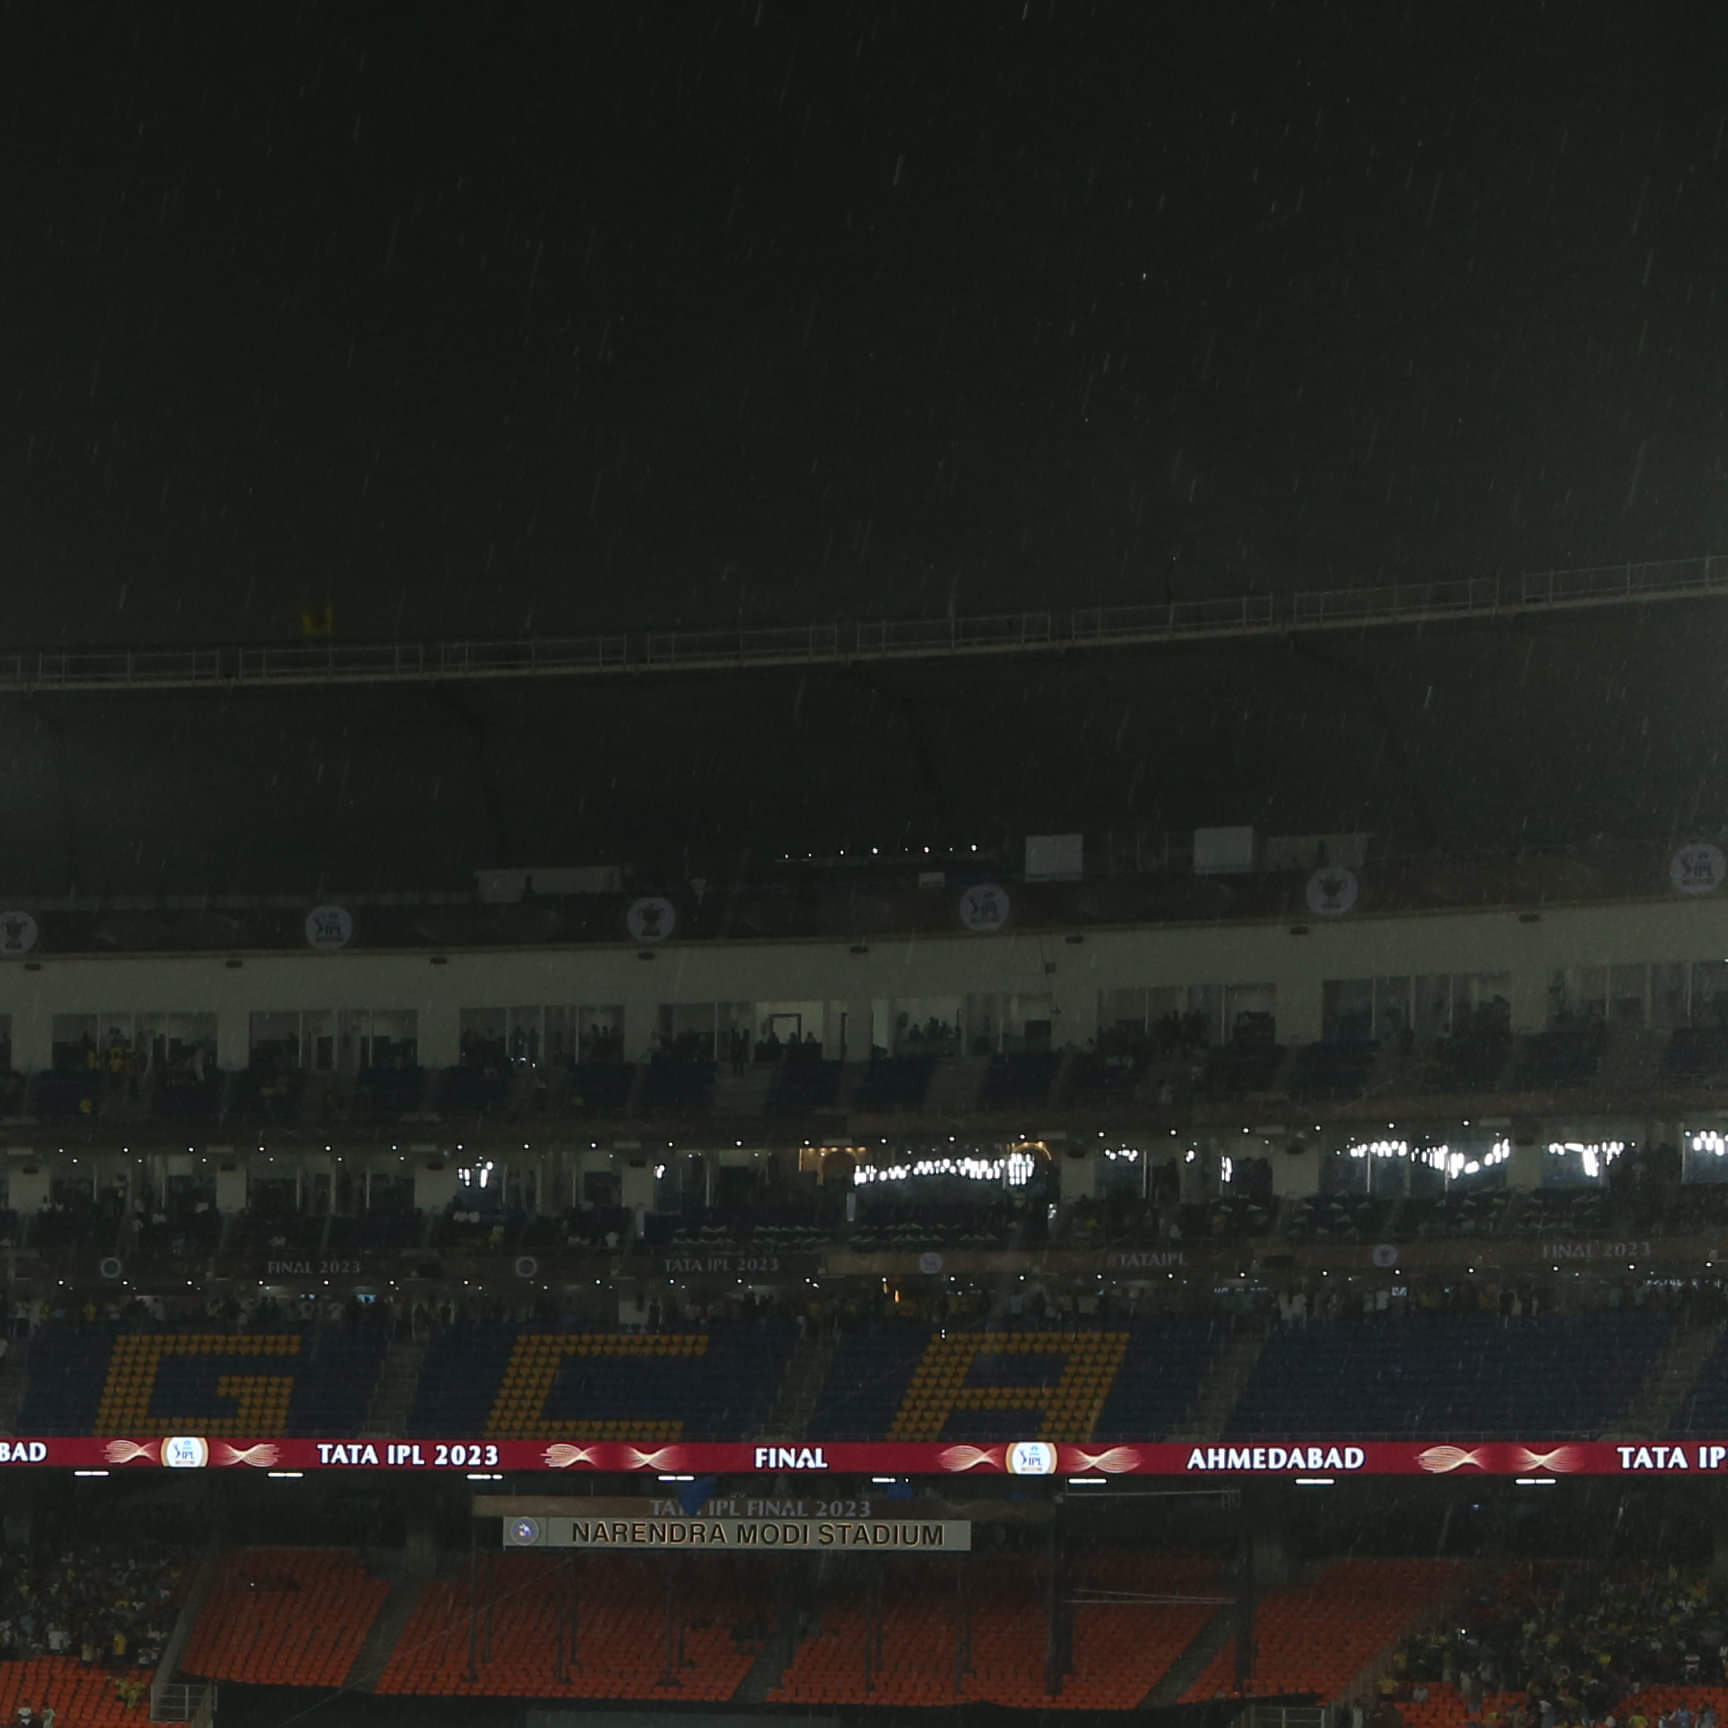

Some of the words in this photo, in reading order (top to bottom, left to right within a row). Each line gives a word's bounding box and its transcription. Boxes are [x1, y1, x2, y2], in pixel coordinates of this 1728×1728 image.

[267, 1260, 313, 1274] FINAL
[318, 1260, 361, 1274] 2023
[664, 1258, 703, 1273] TATA
[707, 1258, 731, 1273] IPL
[736, 1257, 780, 1273] 2023
[317, 1443, 379, 1465] TATA
[387, 1444, 425, 1465] IPL
[434, 1444, 498, 1466] 2023
[755, 1447, 828, 1469] FINAL
[1187, 1447, 1365, 1470] AHMEDABAD
[1616, 1446, 1689, 1469] TATA
[708, 1501, 741, 1517] IPL
[747, 1501, 808, 1518] FINAL
[815, 1501, 872, 1518] 2023
[572, 1521, 727, 1545] NARENDRA
[737, 1522, 810, 1545] MODI
[818, 1522, 945, 1547] STADIUM
